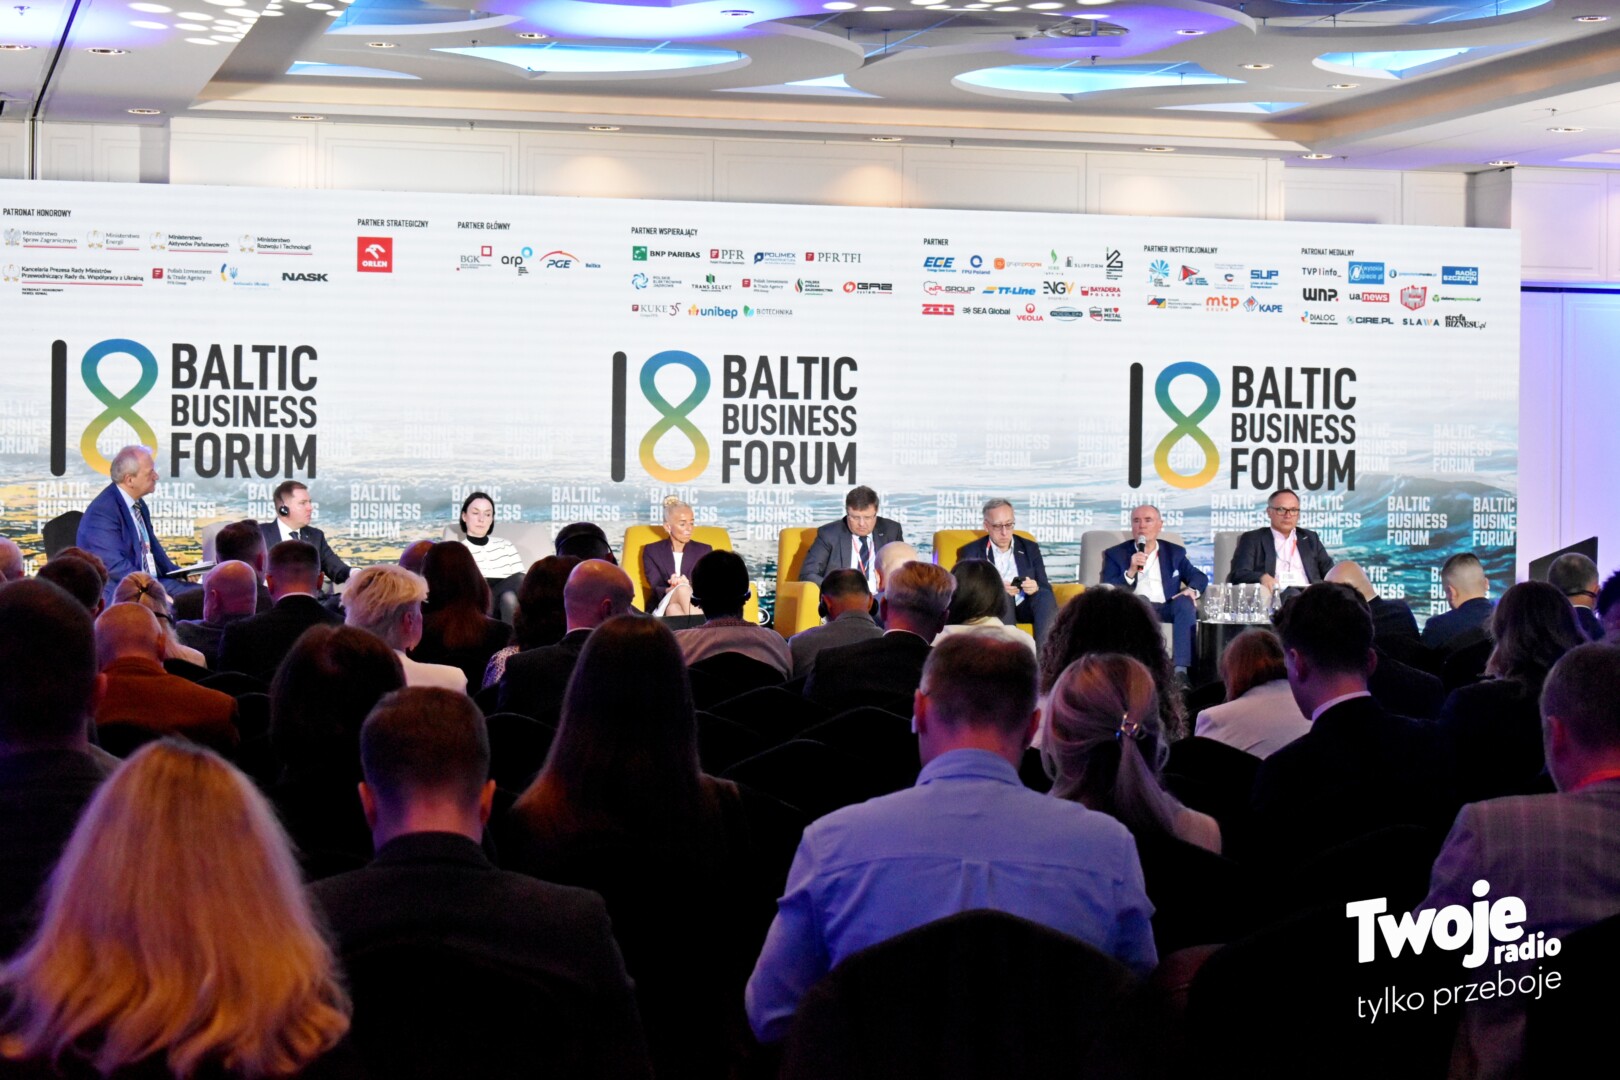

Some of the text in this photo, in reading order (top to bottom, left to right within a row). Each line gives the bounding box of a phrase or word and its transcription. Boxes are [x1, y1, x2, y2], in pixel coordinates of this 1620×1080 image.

[387, 220, 428, 228] STRATEGICZNY
[486, 221, 510, 230] GŁÓWNY
[659, 228, 697, 238] WSPIERAJĄCY
[501, 256, 522, 267] arp
[721, 249, 744, 260] PFR
[818, 252, 861, 263] PFR TFI
[547, 260, 571, 268] PGE
[282, 273, 328, 281] NASK
[1251, 270, 1278, 279] SUP
[999, 287, 1036, 295] TT-Line
[1206, 296, 1239, 309] mtp
[701, 306, 738, 318] unibep
[172, 343, 317, 391] BALTIC
[723, 354, 857, 401] BALTIC
[1232, 365, 1356, 410] BALTIC
[171, 394, 317, 428] BUSINESS
[611, 350, 710, 483] 18
[0, 418, 50, 435] USINES
[722, 403, 857, 436] BUSINESS
[1128, 361, 1220, 489] 18
[1231, 413, 1356, 444] BUSINESS
[1434, 425, 1476, 438] BALTIC
[0, 437, 38, 454] ORUM
[986, 434, 1050, 449] BUSINESS
[1078, 435, 1128, 450] BUSINE
[1356, 440, 1407, 455] USINESS
[1434, 441, 1492, 456] BUSINESS
[171, 432, 316, 479] FORUM
[722, 440, 857, 485] FORUM
[892, 450, 939, 465] FORUM
[985, 452, 1031, 467] FORUM
[1078, 452, 1122, 468] FORUM
[1356, 456, 1389, 471] ORUM
[1231, 448, 1355, 491] FORUM
[1433, 458, 1474, 473] FORUM
[38, 482, 90, 498] BALTIC
[350, 484, 401, 501] BALTIC
[552, 486, 601, 503] BALTIC
[748, 488, 794, 505] BALTIC
[936, 492, 982, 507] BALTIC
[1029, 492, 1074, 508] BALTIC
[1211, 495, 1255, 510] BALTIC
[1300, 495, 1344, 510] BALTIC
[1387, 496, 1430, 512] BALTIC
[1473, 497, 1515, 512] BALTIC
[37, 500, 90, 517] BUSIN
[350, 503, 421, 519] BUSINESS
[551, 506, 620, 522] BUSINESS
[747, 507, 814, 523] BUSINESS
[937, 508, 983, 524] BUSINE
[1029, 510, 1093, 525] BUSINESS
[1211, 511, 1270, 526] BUSINESS
[1299, 512, 1361, 528] BUSINESS
[1387, 514, 1448, 529] BUSINESS
[1473, 514, 1516, 530] BUSINE
[153, 519, 194, 536] ORUM
[350, 522, 400, 538] FORUM
[747, 524, 792, 541] FORU
[1317, 529, 1343, 544] RUM
[1387, 530, 1429, 546] FORUM
[1472, 531, 1514, 546] FORUM
